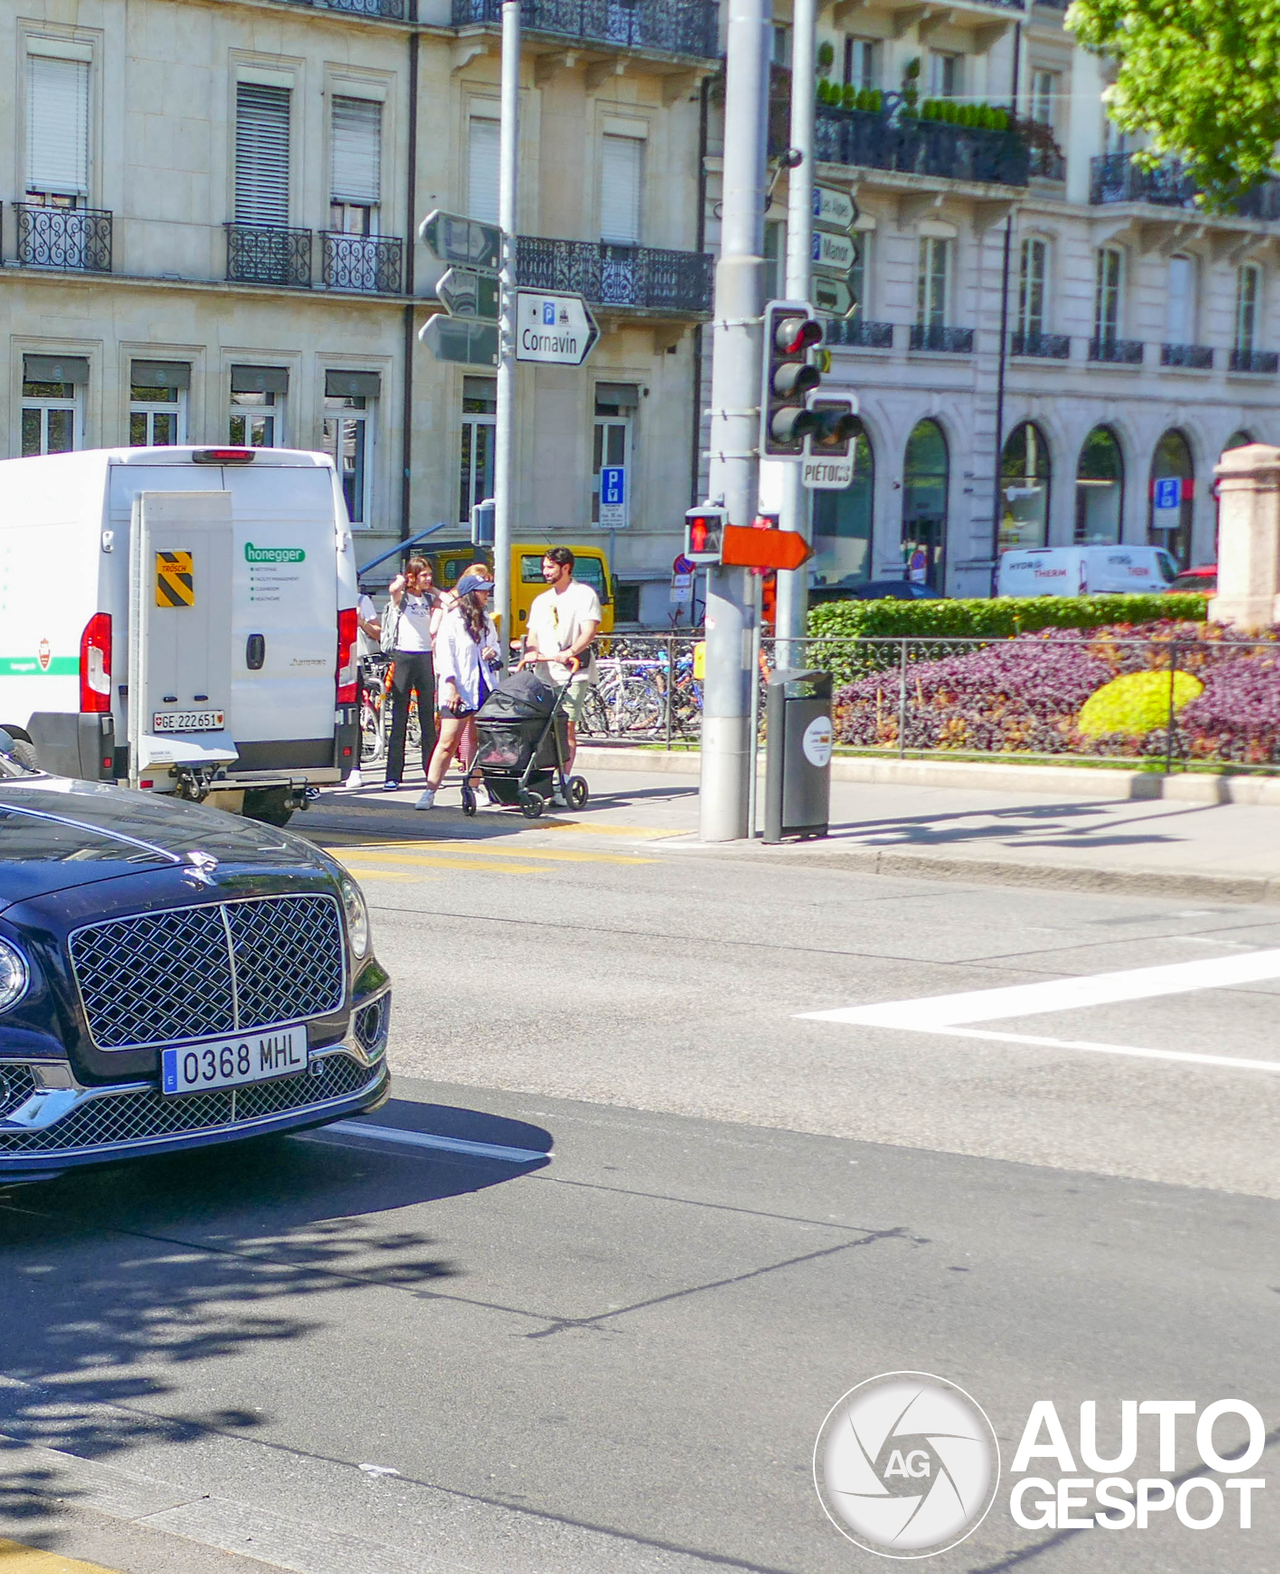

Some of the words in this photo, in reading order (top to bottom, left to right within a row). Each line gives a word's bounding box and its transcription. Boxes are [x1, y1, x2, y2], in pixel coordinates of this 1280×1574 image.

[823, 237, 849, 262] Manor
[522, 328, 577, 354] Cornavin
[609, 471, 618, 488] P
[247, 545, 302, 562] honegger
[162, 563, 187, 572] TRÖSCH
[1034, 568, 1067, 578] THERM
[167, 1075, 174, 1085] E
[184, 1043, 250, 1084] 0368
[260, 1034, 301, 1071] MHL
